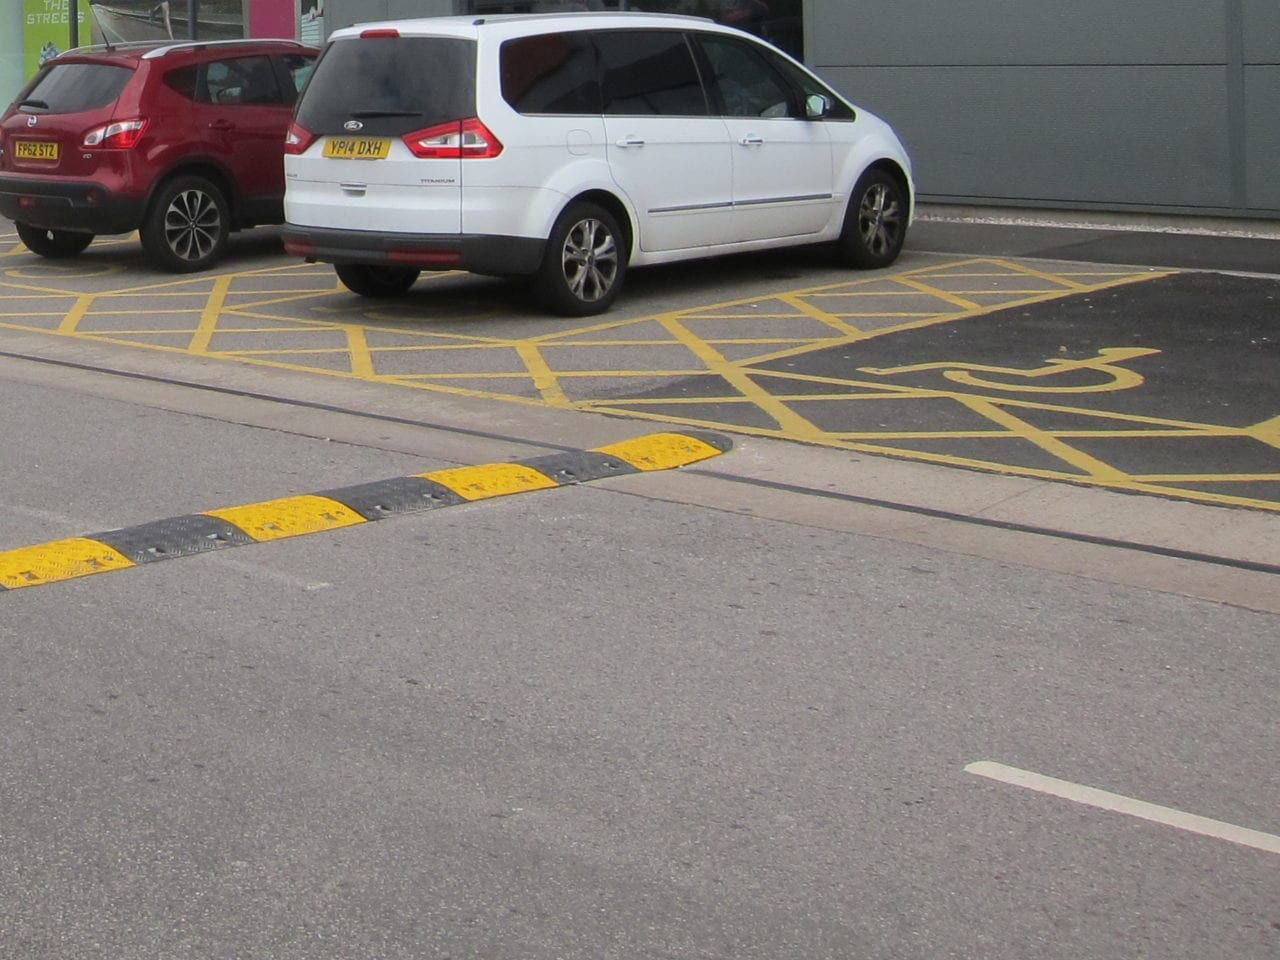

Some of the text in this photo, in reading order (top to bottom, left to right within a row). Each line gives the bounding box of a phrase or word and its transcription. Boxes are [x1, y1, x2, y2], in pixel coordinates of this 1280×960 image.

[43, 0, 69, 10] THE
[27, 11, 85, 25] STREES
[18, 142, 37, 156] FP62
[331, 140, 382, 156] YP14 DXH
